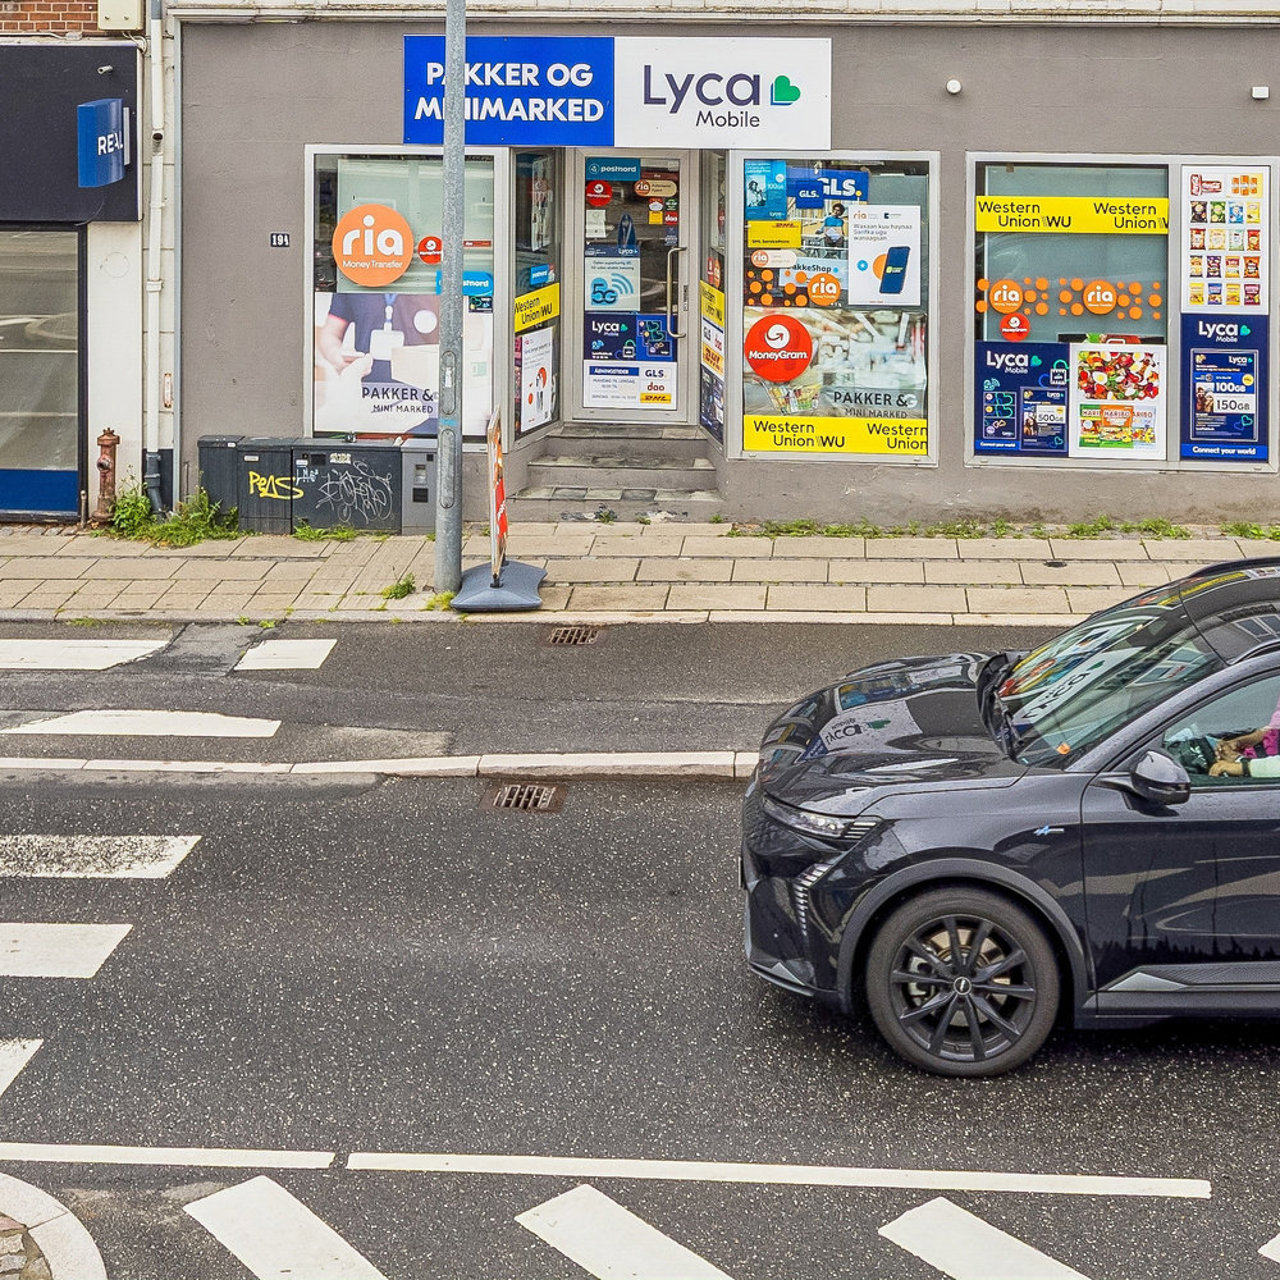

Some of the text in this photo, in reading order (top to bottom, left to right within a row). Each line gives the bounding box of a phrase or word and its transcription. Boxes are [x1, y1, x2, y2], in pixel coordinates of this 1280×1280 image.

[427, 62, 593, 87] PKKER OG
[644, 65, 760, 114] Lyca
[696, 111, 760, 128] Mobile
[97, 130, 125, 156] REAL
[978, 201, 1040, 214] Western
[1094, 203, 1157, 215] Western
[853, 210, 867, 219] ria
[998, 215, 1040, 227] Union
[1114, 217, 1157, 229] Union
[342, 215, 404, 256] ria
[343, 260, 403, 270] Money Transfer
[791, 264, 831, 273] akkeShop
[812, 277, 837, 294] ria
[592, 283, 617, 304] 5G
[994, 284, 1019, 301] ria
[1087, 285, 1113, 302] ria
[592, 321, 619, 333] Lyca
[1199, 320, 1238, 338] Lyca
[986, 350, 1029, 369] Lyca
[1228, 355, 1247, 364] Lyca
[647, 382, 665, 391] dao
[362, 387, 418, 401] PAKKER
[834, 391, 892, 406] PAKKER
[373, 404, 433, 413] MINI MARKED
[1217, 400, 1250, 410] 150GB
[845, 408, 907, 419] MINI MARKED
[754, 420, 814, 434] Western
[867, 423, 927, 436] Western
[773, 434, 814, 447] Union
[886, 437, 927, 450] Union
[1192, 446, 1220, 454] Connect
